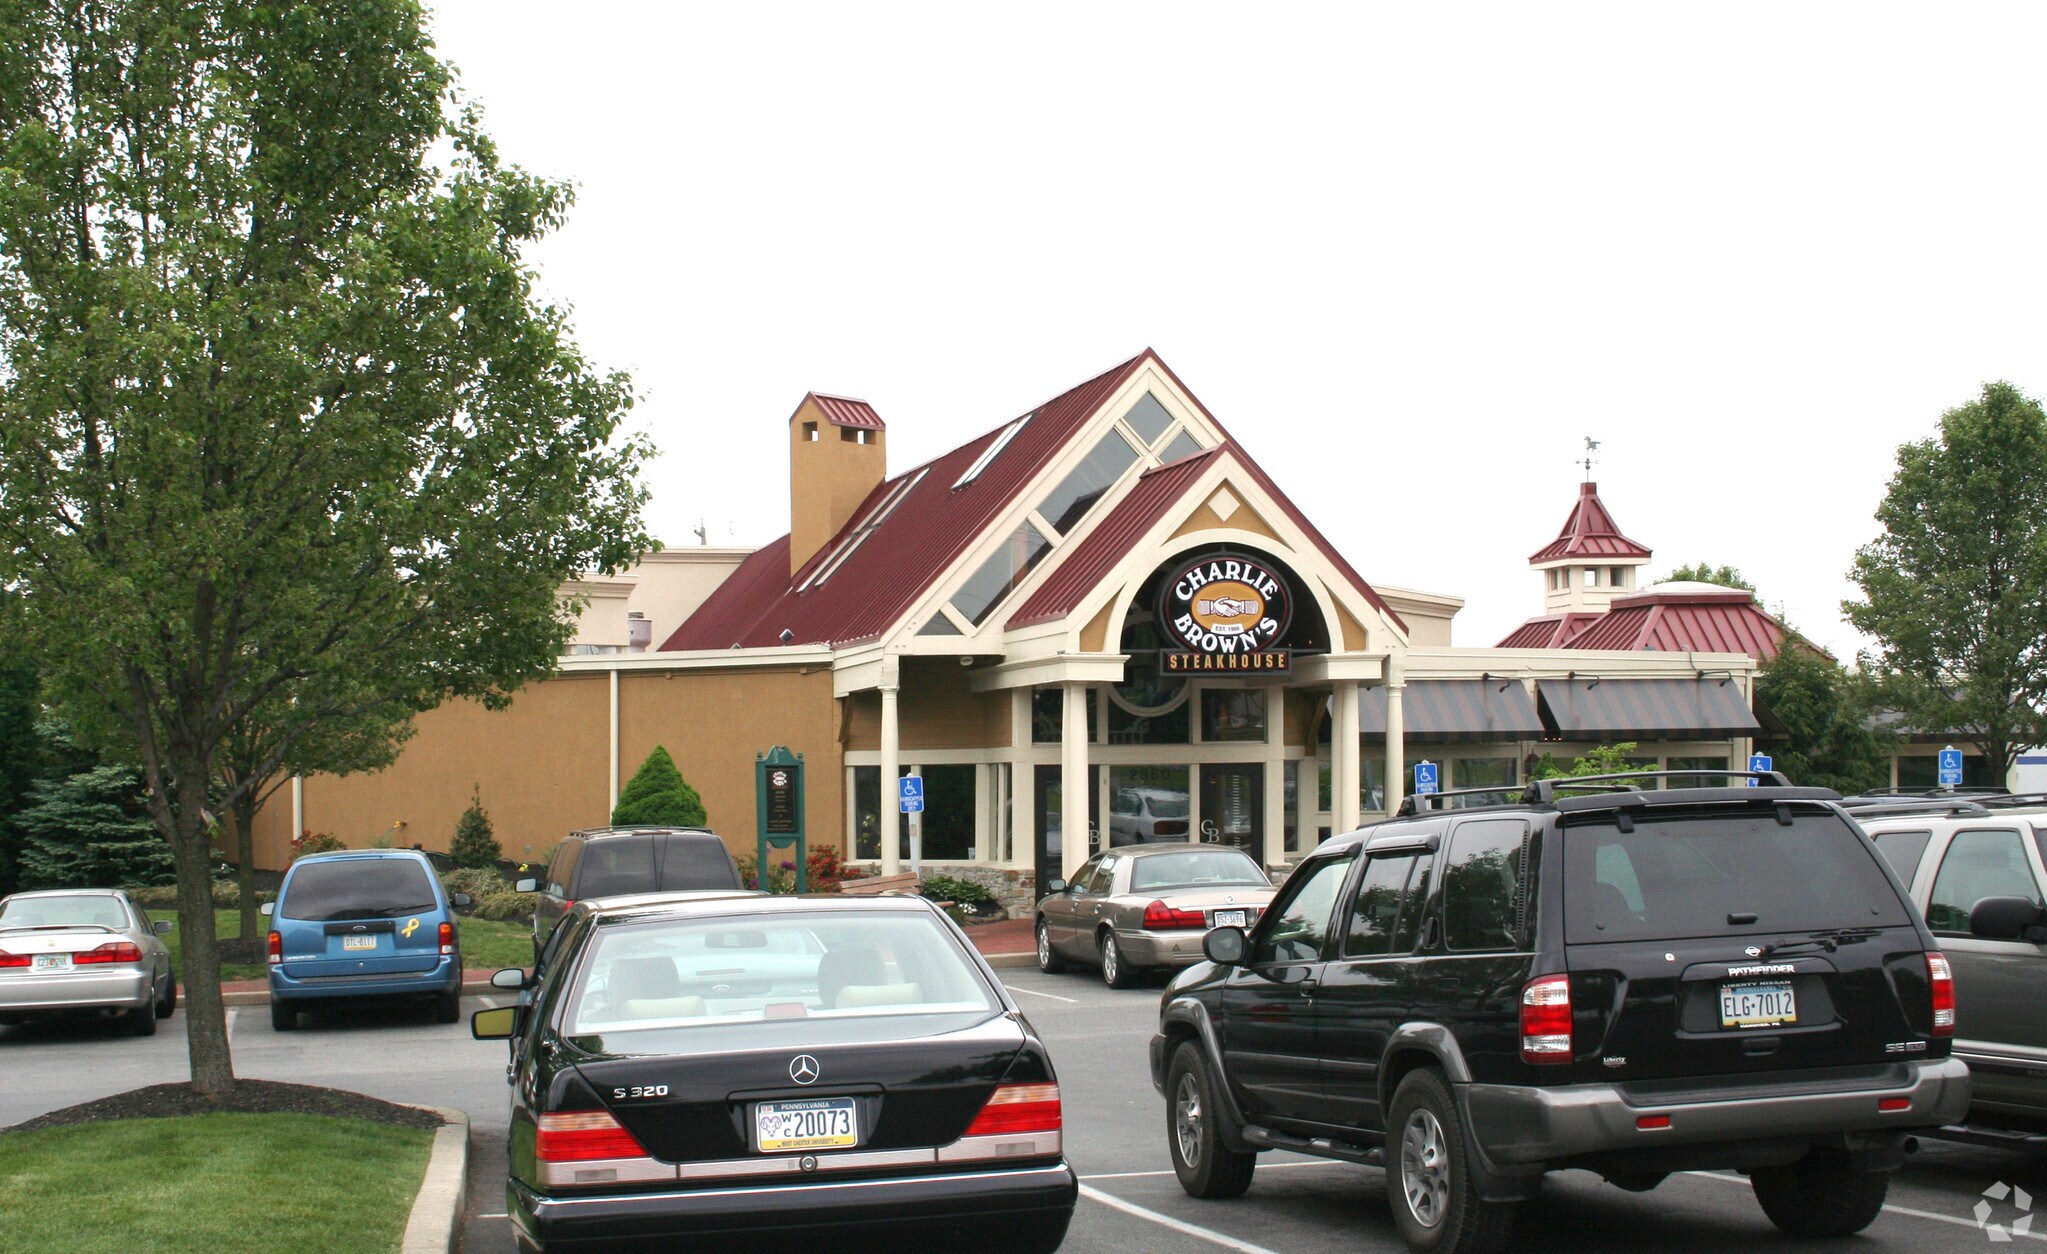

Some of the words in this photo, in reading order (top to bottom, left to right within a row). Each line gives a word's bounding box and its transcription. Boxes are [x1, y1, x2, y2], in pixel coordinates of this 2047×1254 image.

[1175, 561, 1278, 601] CHARLIE
[1174, 613, 1278, 653] BROWN'S
[1170, 654, 1285, 669] STEAKHOUSE
[1728, 965, 1795, 977] PATHFINDER
[613, 1087, 626, 1099] S
[630, 1085, 668, 1098] 320
[781, 1101, 830, 1110] PENNSYLVANIA
[794, 1109, 850, 1138] 20073
